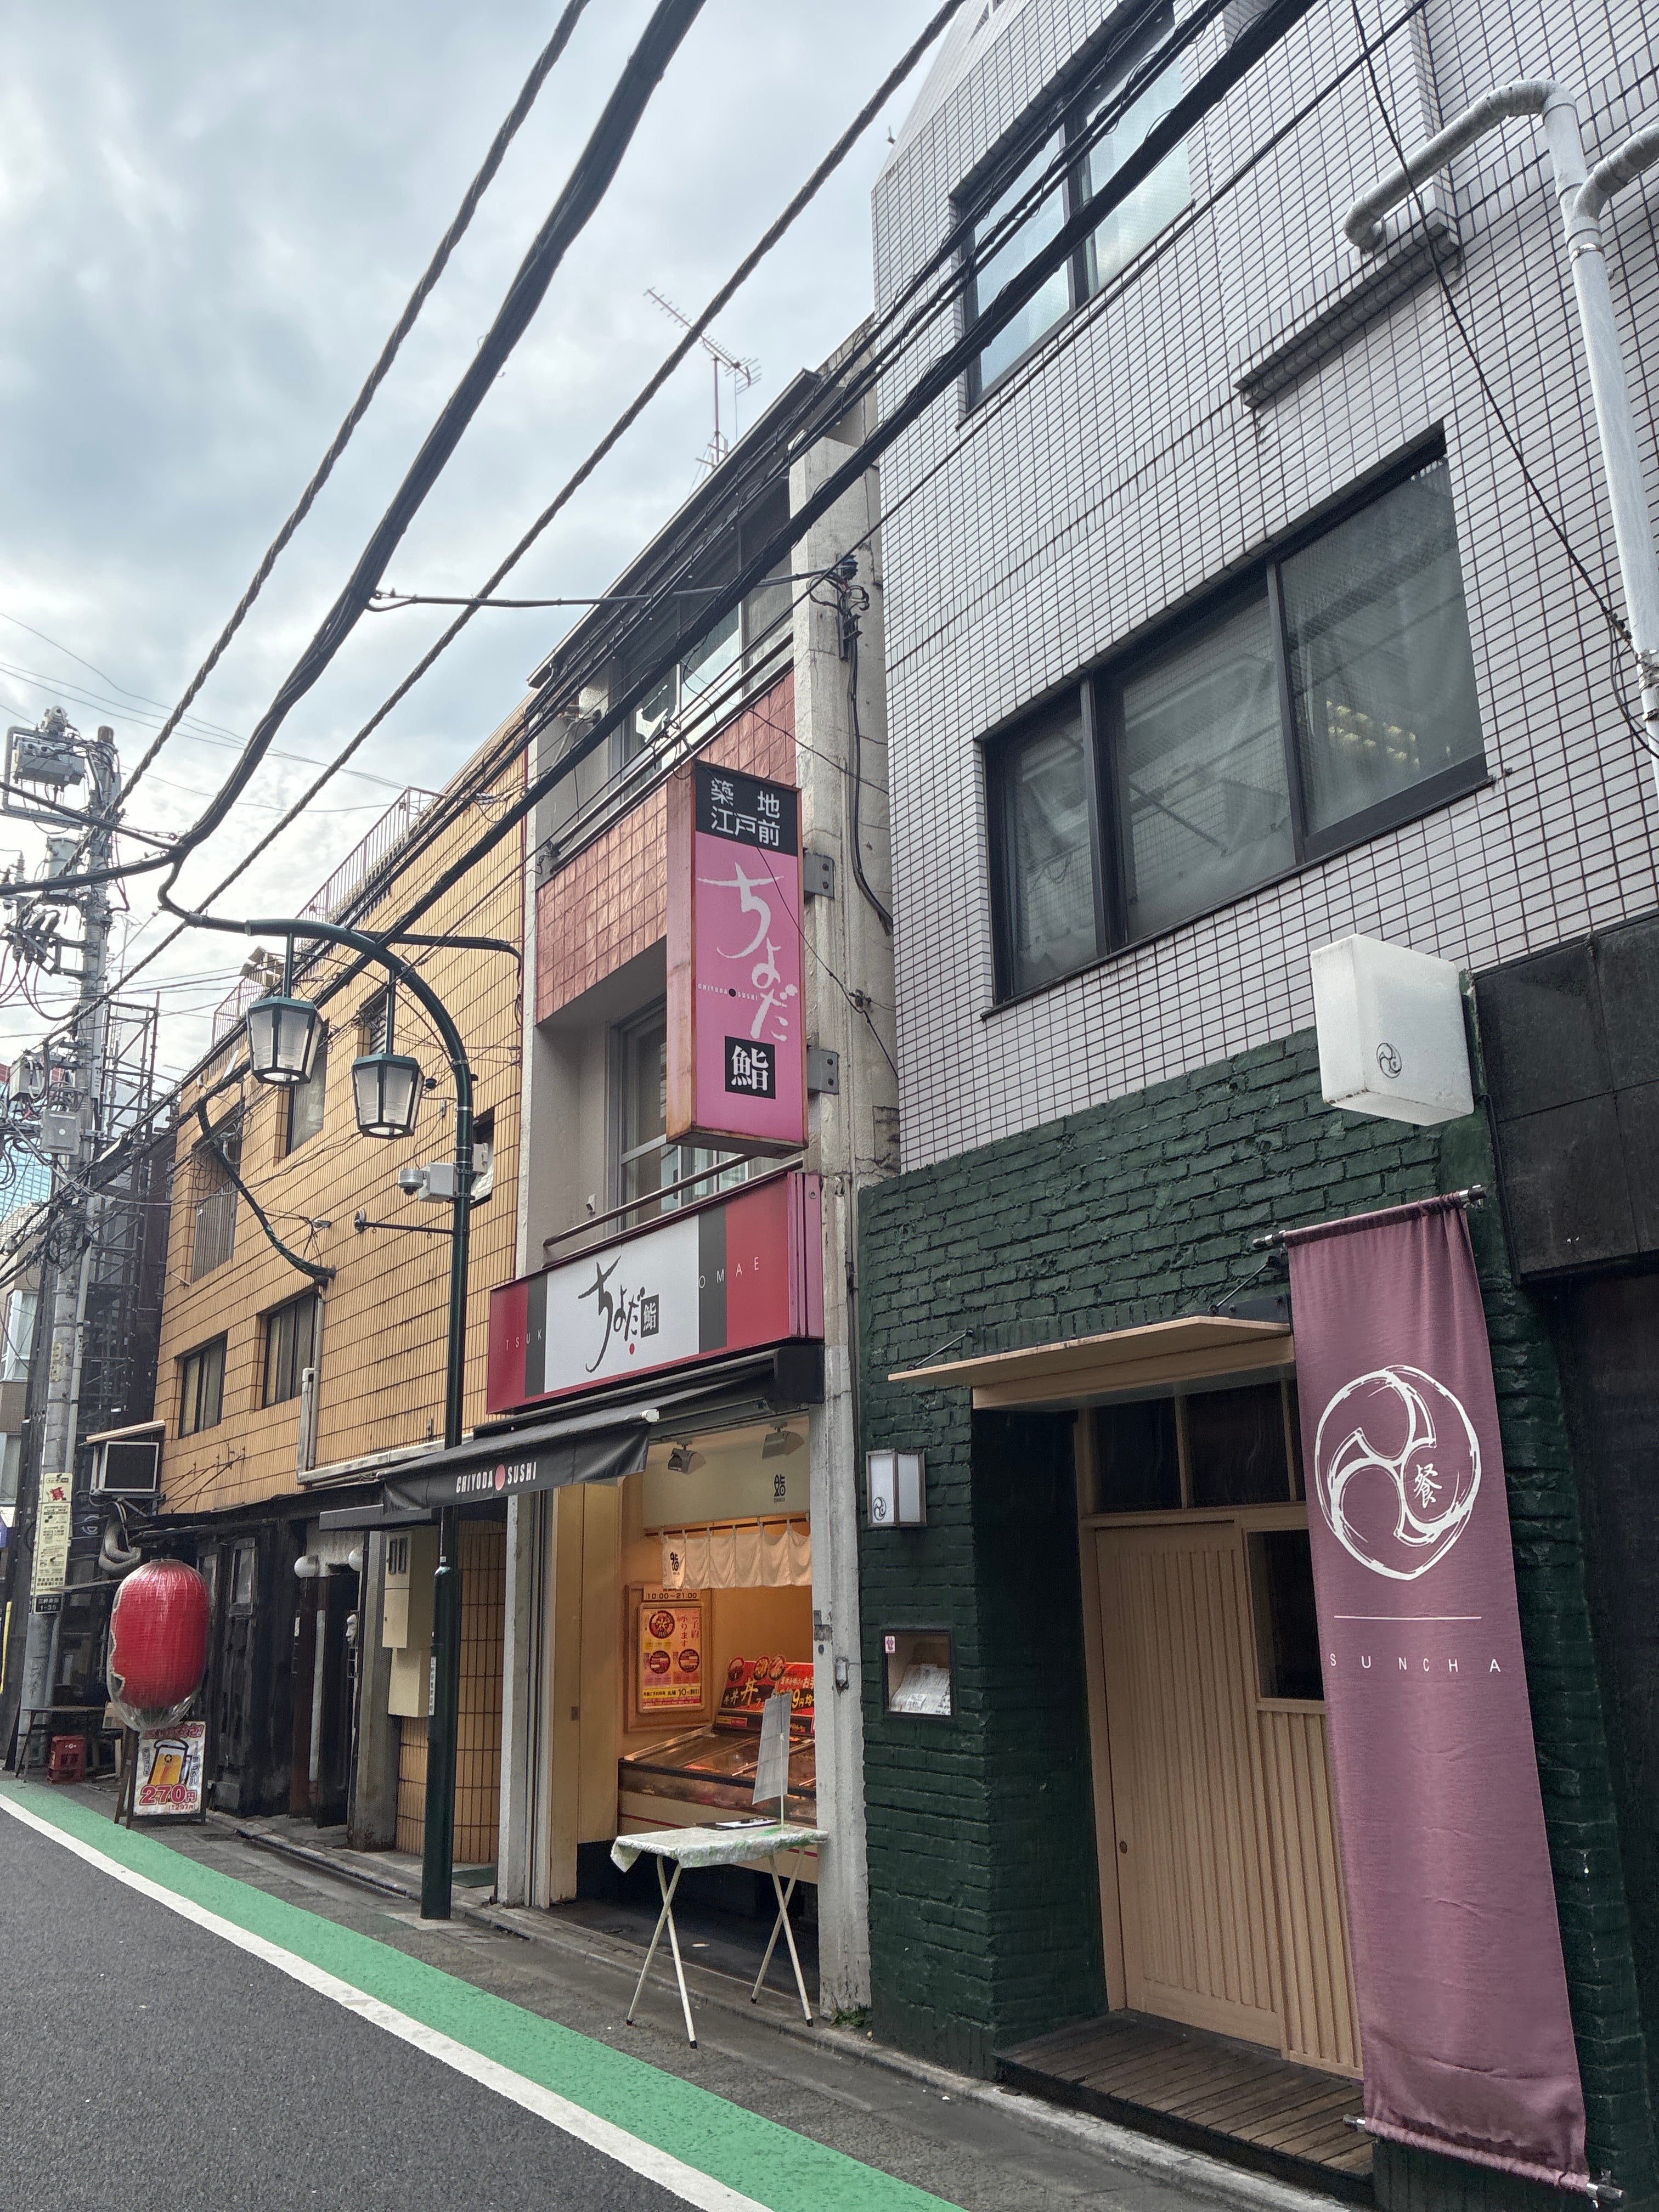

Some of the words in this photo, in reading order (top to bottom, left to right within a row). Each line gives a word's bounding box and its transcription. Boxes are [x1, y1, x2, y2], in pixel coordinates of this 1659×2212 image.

[711, 777, 780, 819] 築地
[711, 805, 780, 846] 江戸前
[698, 983, 727, 995] CHIYODA
[737, 991, 758, 1001] SUSHI
[730, 1044, 769, 1091] 鮨
[642, 1301, 657, 1332] 鮨
[456, 1470, 493, 1493] CHIYODA
[507, 1462, 537, 1485] SUSHI
[1330, 1653, 1501, 1673] SUNCHA
[139, 1784, 197, 1805] 270円
